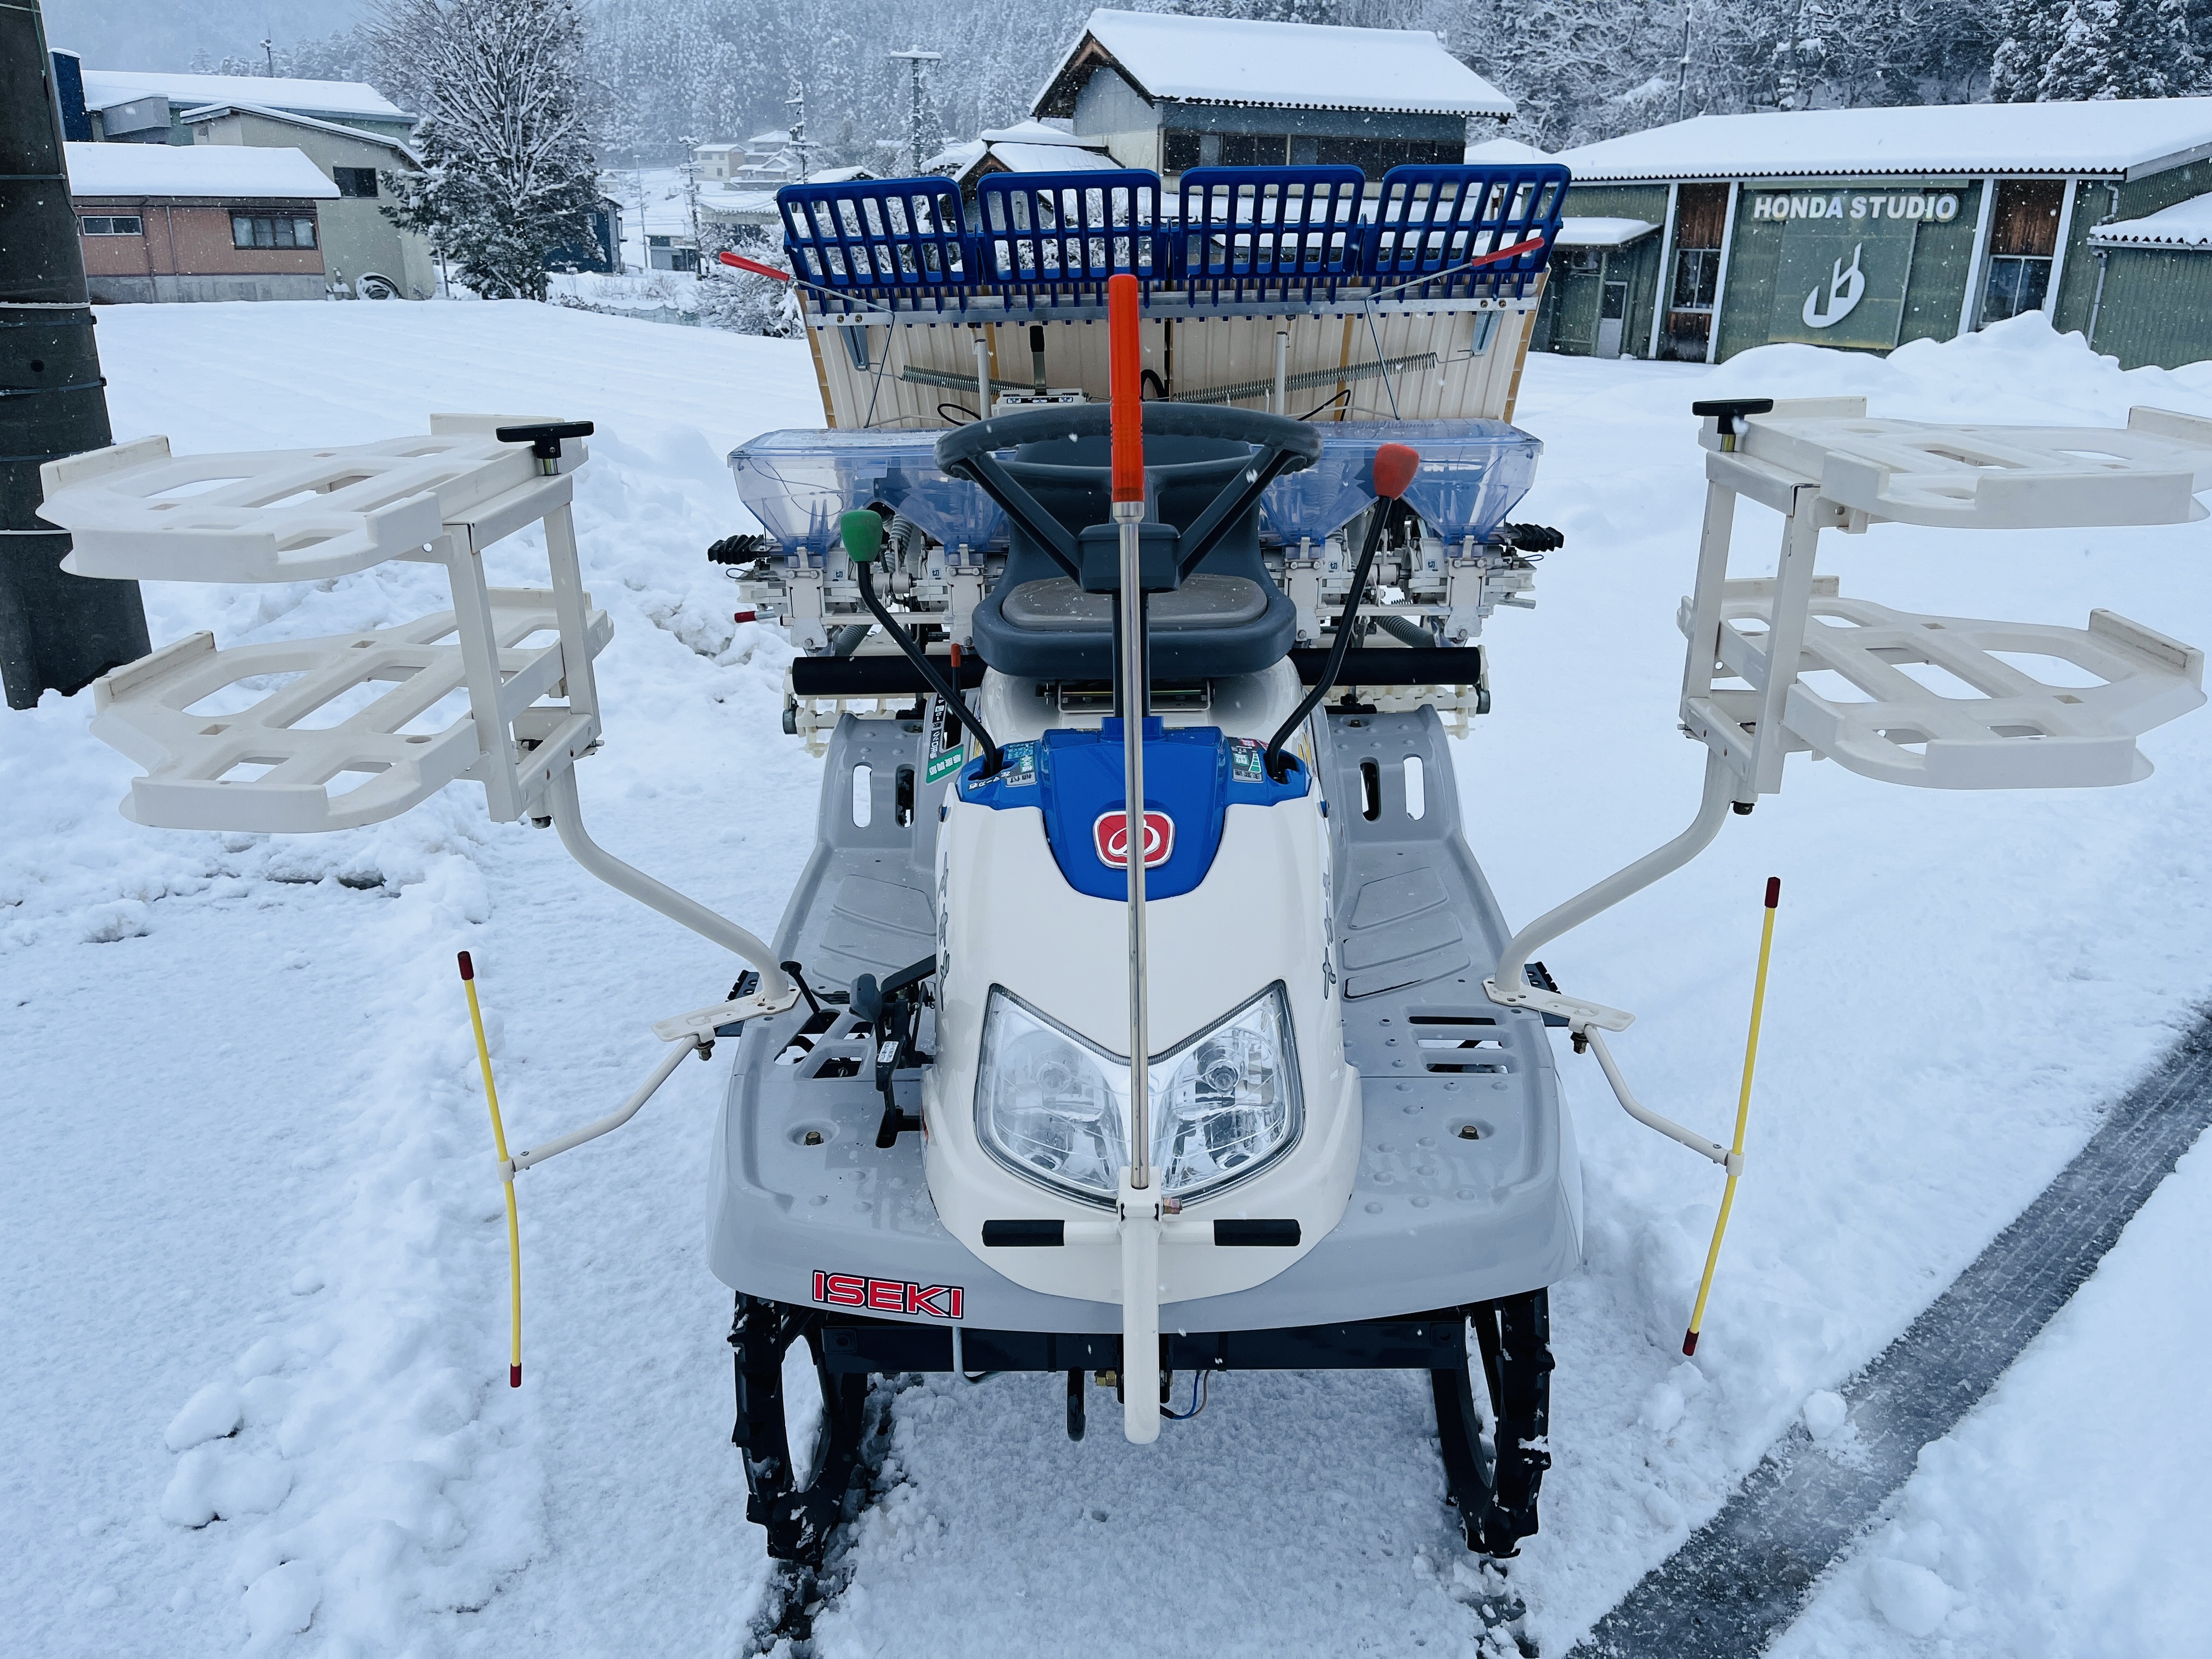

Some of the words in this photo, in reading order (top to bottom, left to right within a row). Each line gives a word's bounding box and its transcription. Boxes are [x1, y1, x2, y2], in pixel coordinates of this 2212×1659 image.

[1752, 195, 1843, 220] HONDA
[1849, 194, 1960, 222] STUDIO
[812, 1269, 964, 1319] ISEKI
